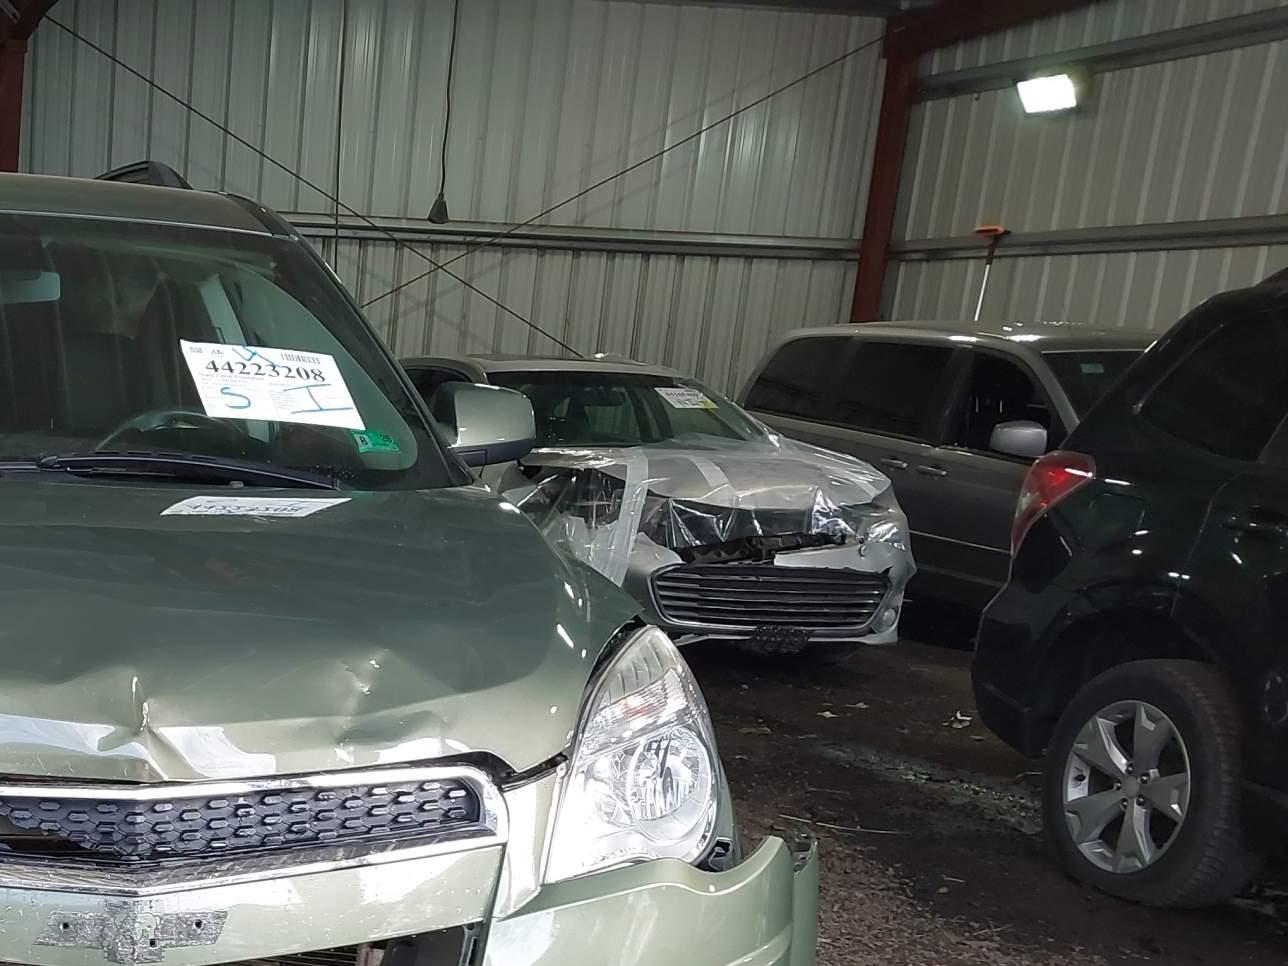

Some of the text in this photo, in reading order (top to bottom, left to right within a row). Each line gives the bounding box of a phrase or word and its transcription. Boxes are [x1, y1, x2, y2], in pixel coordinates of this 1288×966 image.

[205, 359, 326, 383] 44223208
[220, 386, 251, 409] S
[283, 383, 354, 414] I
